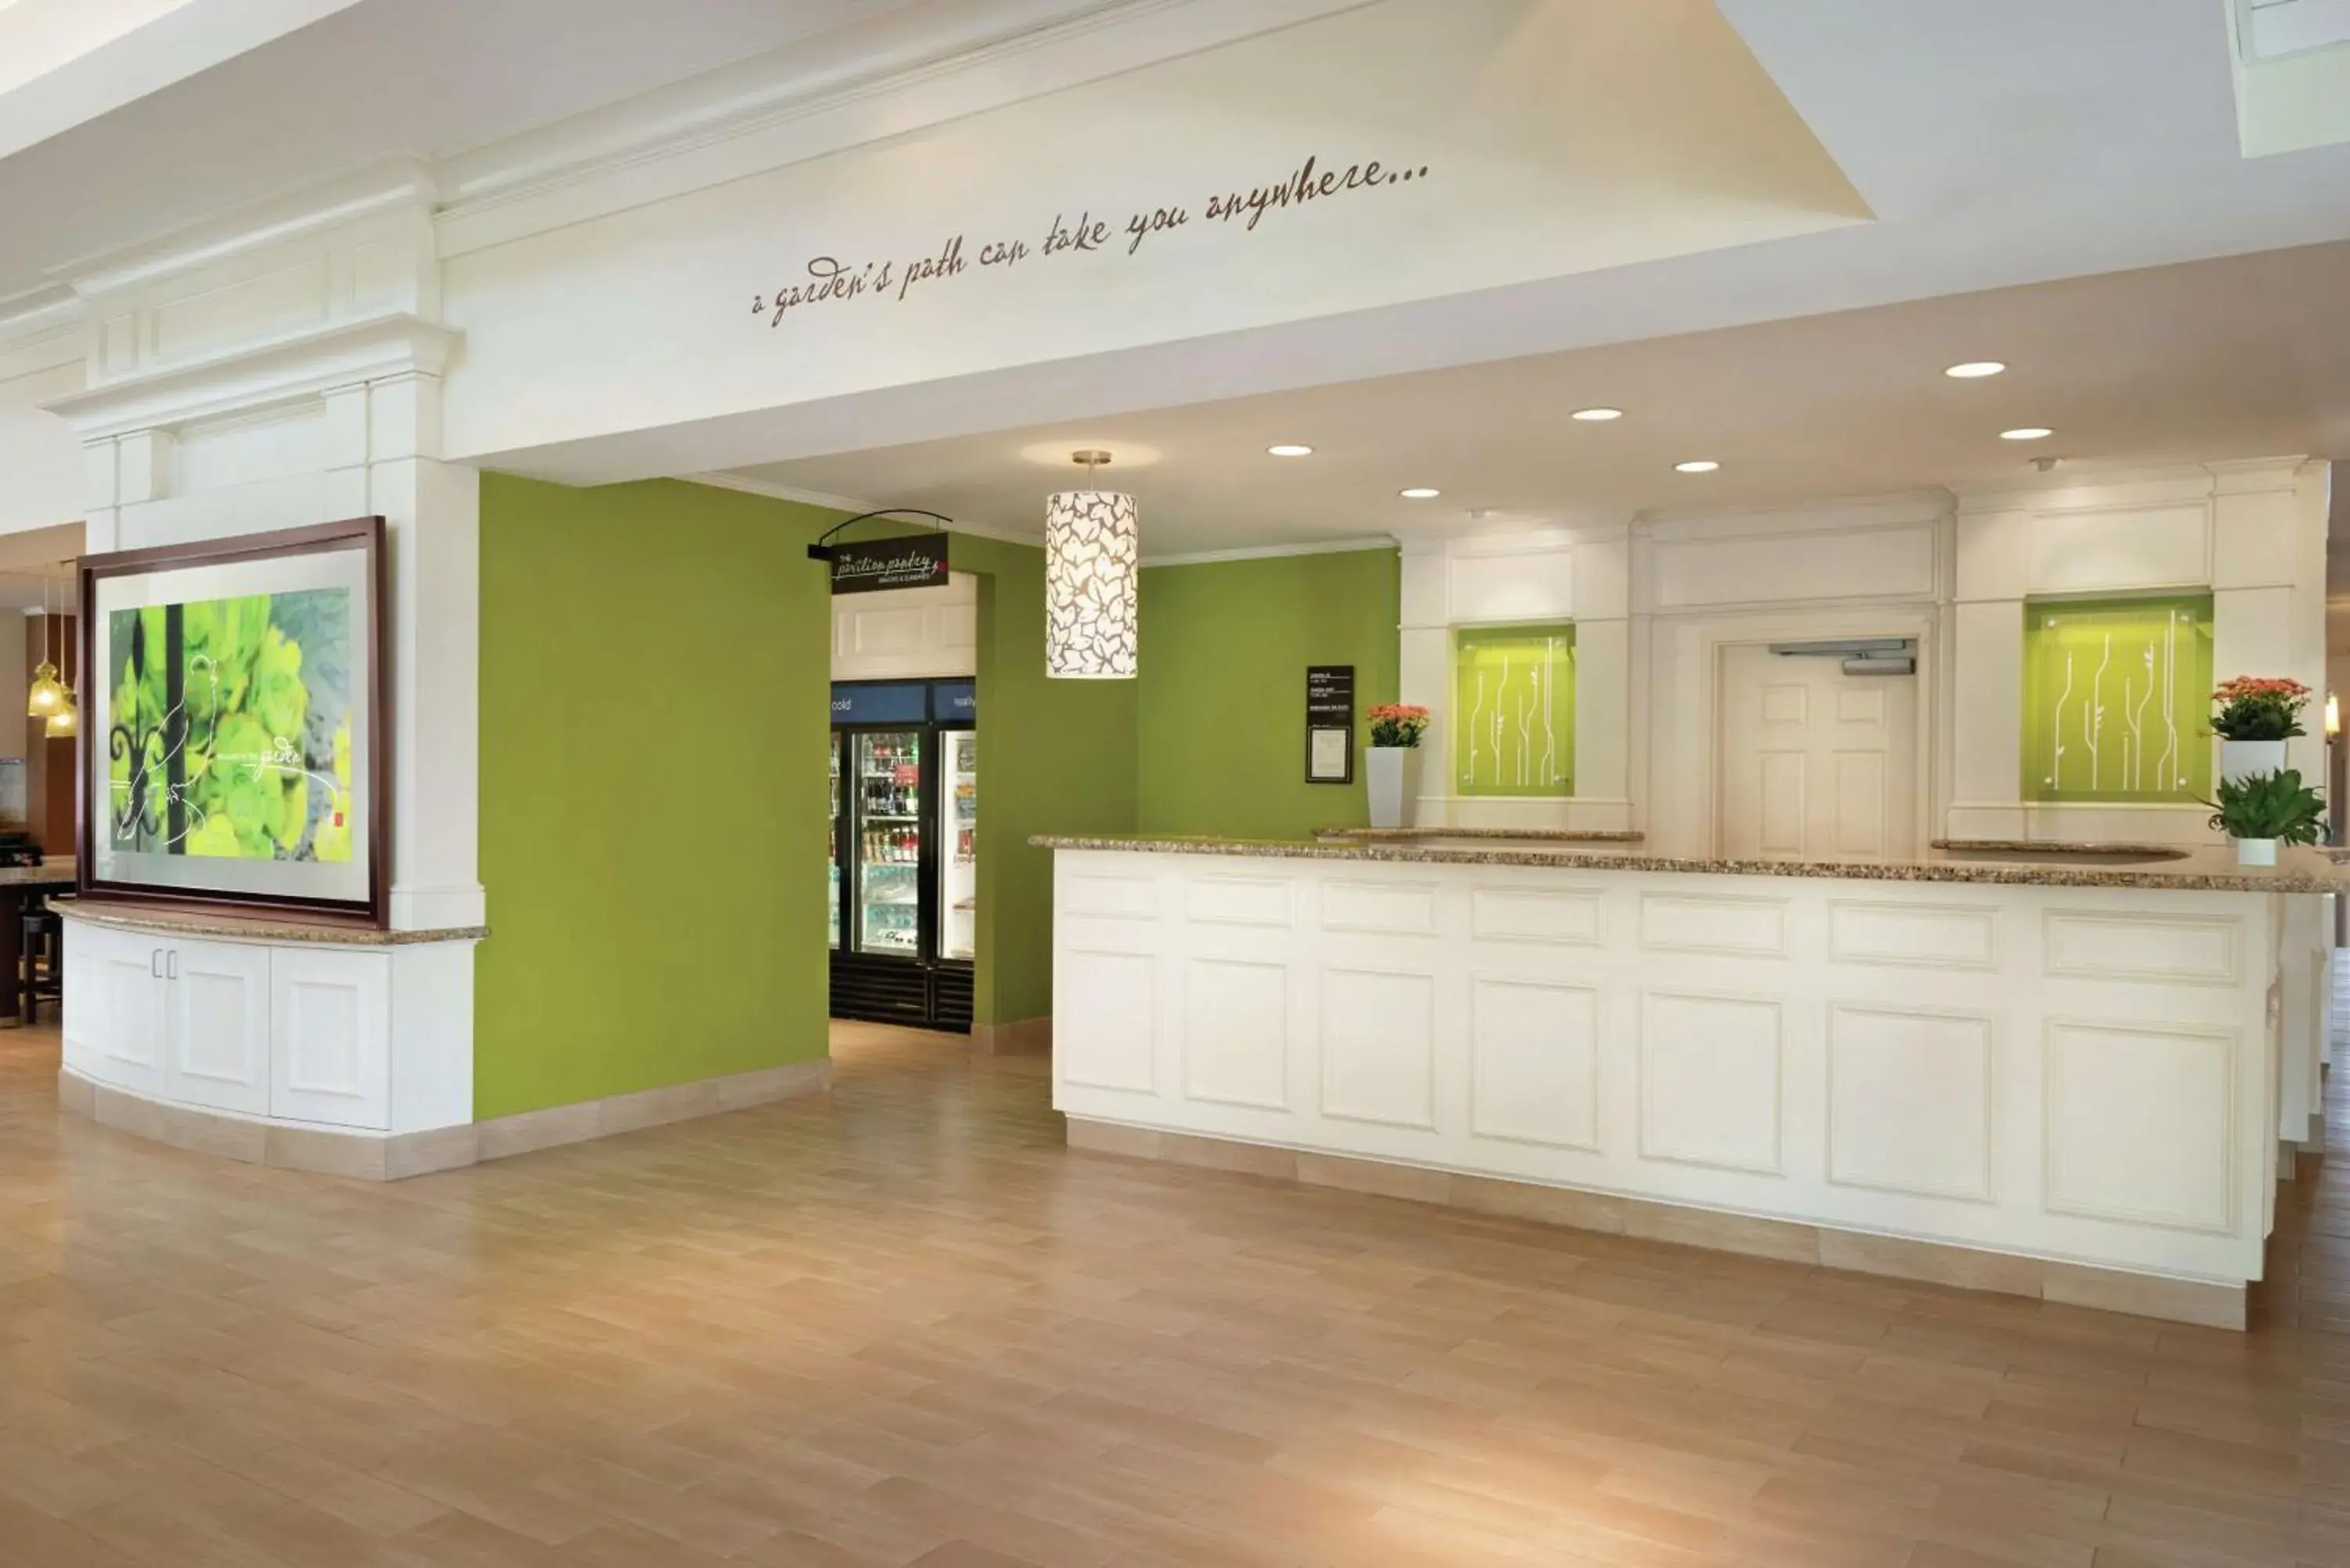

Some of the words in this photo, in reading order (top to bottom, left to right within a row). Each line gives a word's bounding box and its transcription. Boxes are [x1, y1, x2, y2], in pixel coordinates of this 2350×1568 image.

[750, 294, 765, 314] a
[771, 256, 894, 328] garden's
[898, 235, 968, 302] path
[979, 240, 1030, 267] can
[1042, 211, 1111, 257] take
[1125, 207, 1189, 256] you
[1205, 155, 1429, 233] anywhere...
[831, 698, 851, 711] cold
